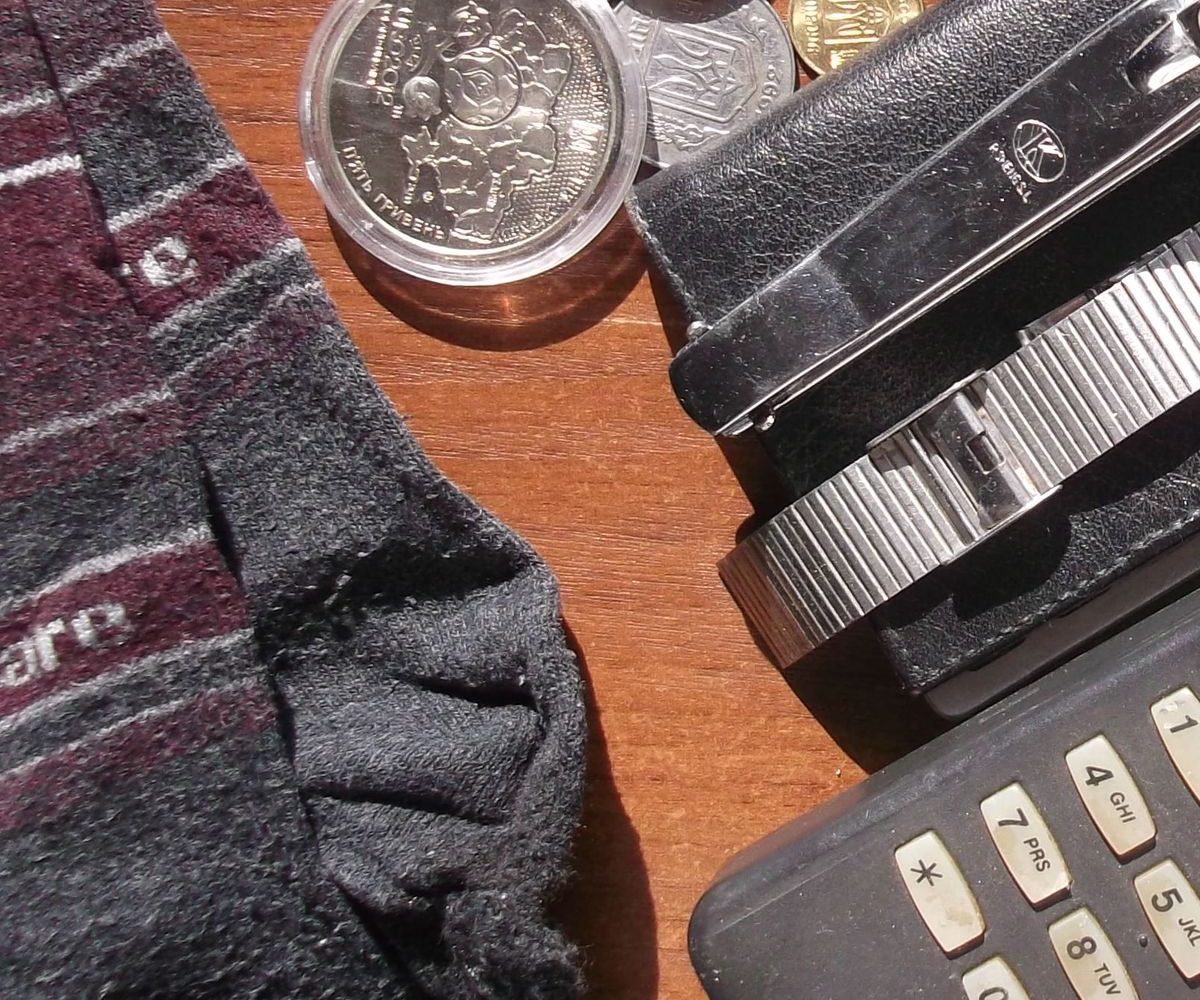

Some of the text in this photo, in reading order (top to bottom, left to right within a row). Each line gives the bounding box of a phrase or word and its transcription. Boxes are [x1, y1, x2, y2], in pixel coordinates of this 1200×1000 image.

[1169, 714, 1199, 735] 1
[1084, 765, 1137, 825] 4 GHI
[998, 807, 1052, 874] 7 PRS
[1150, 887, 1184, 914] 5
[1066, 936, 1122, 996] 8 TUV
